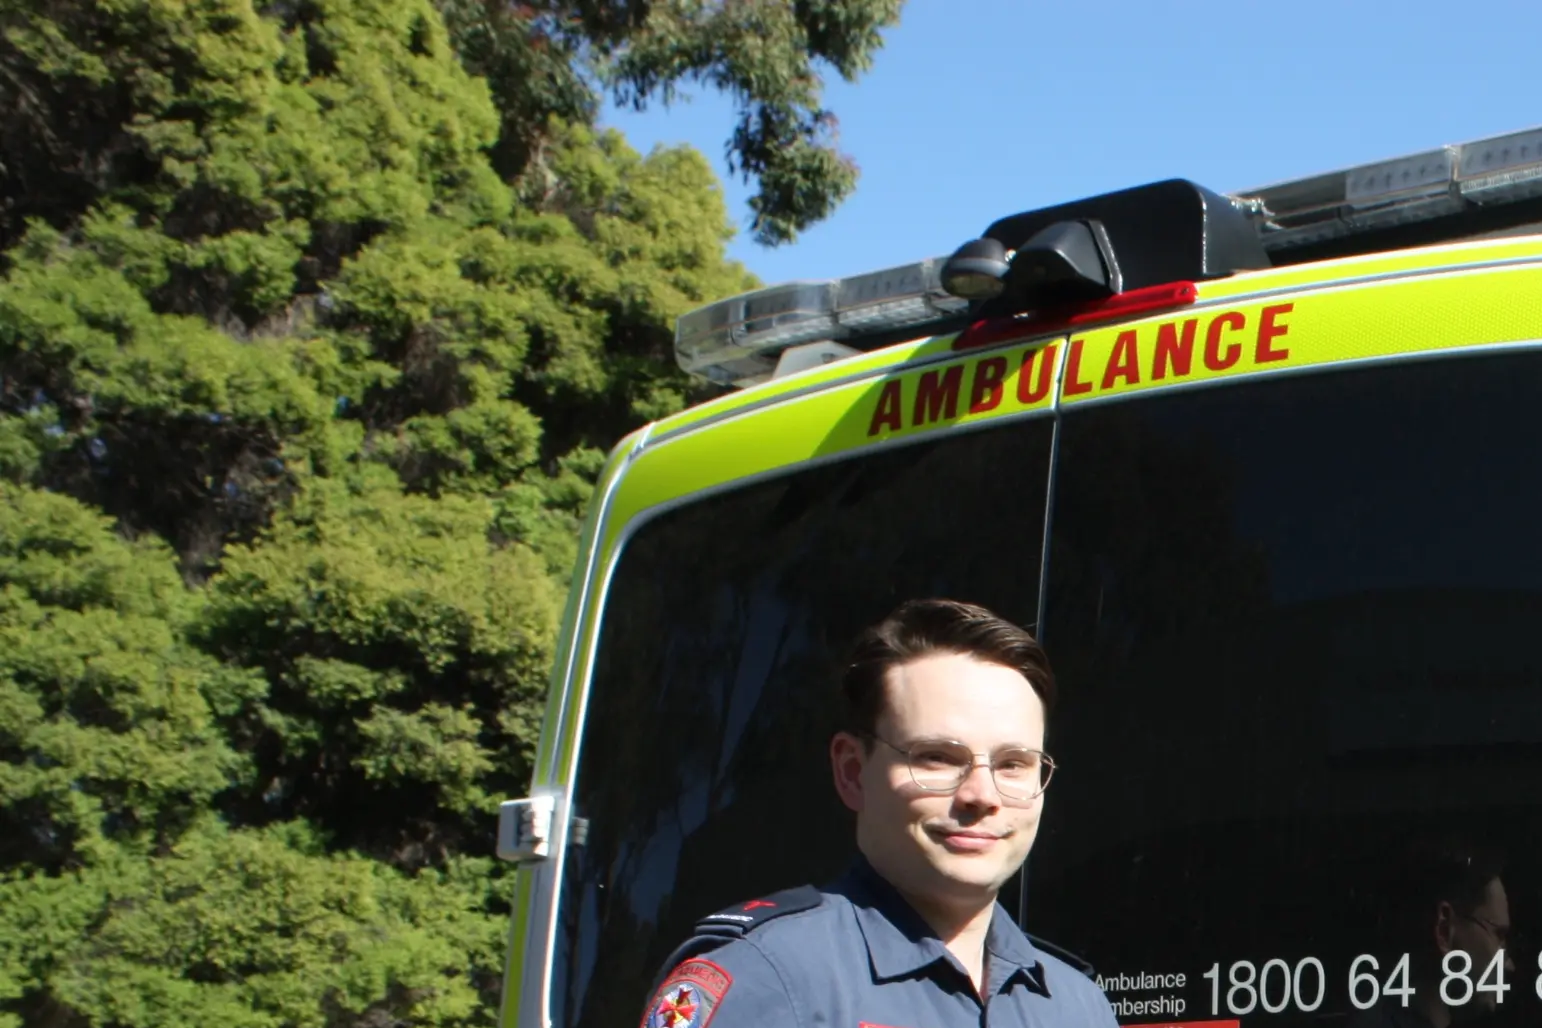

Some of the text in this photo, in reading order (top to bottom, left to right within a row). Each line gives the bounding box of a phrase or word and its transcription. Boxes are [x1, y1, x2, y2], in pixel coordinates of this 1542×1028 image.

[867, 302, 1294, 437] AMBULANCE
[1095, 971, 1186, 992] Ambulance
[1202, 956, 1326, 1016] 1800
[1347, 952, 1416, 1010] 64
[1439, 948, 1512, 1006] 84
[1110, 995, 1186, 1016] mbership
